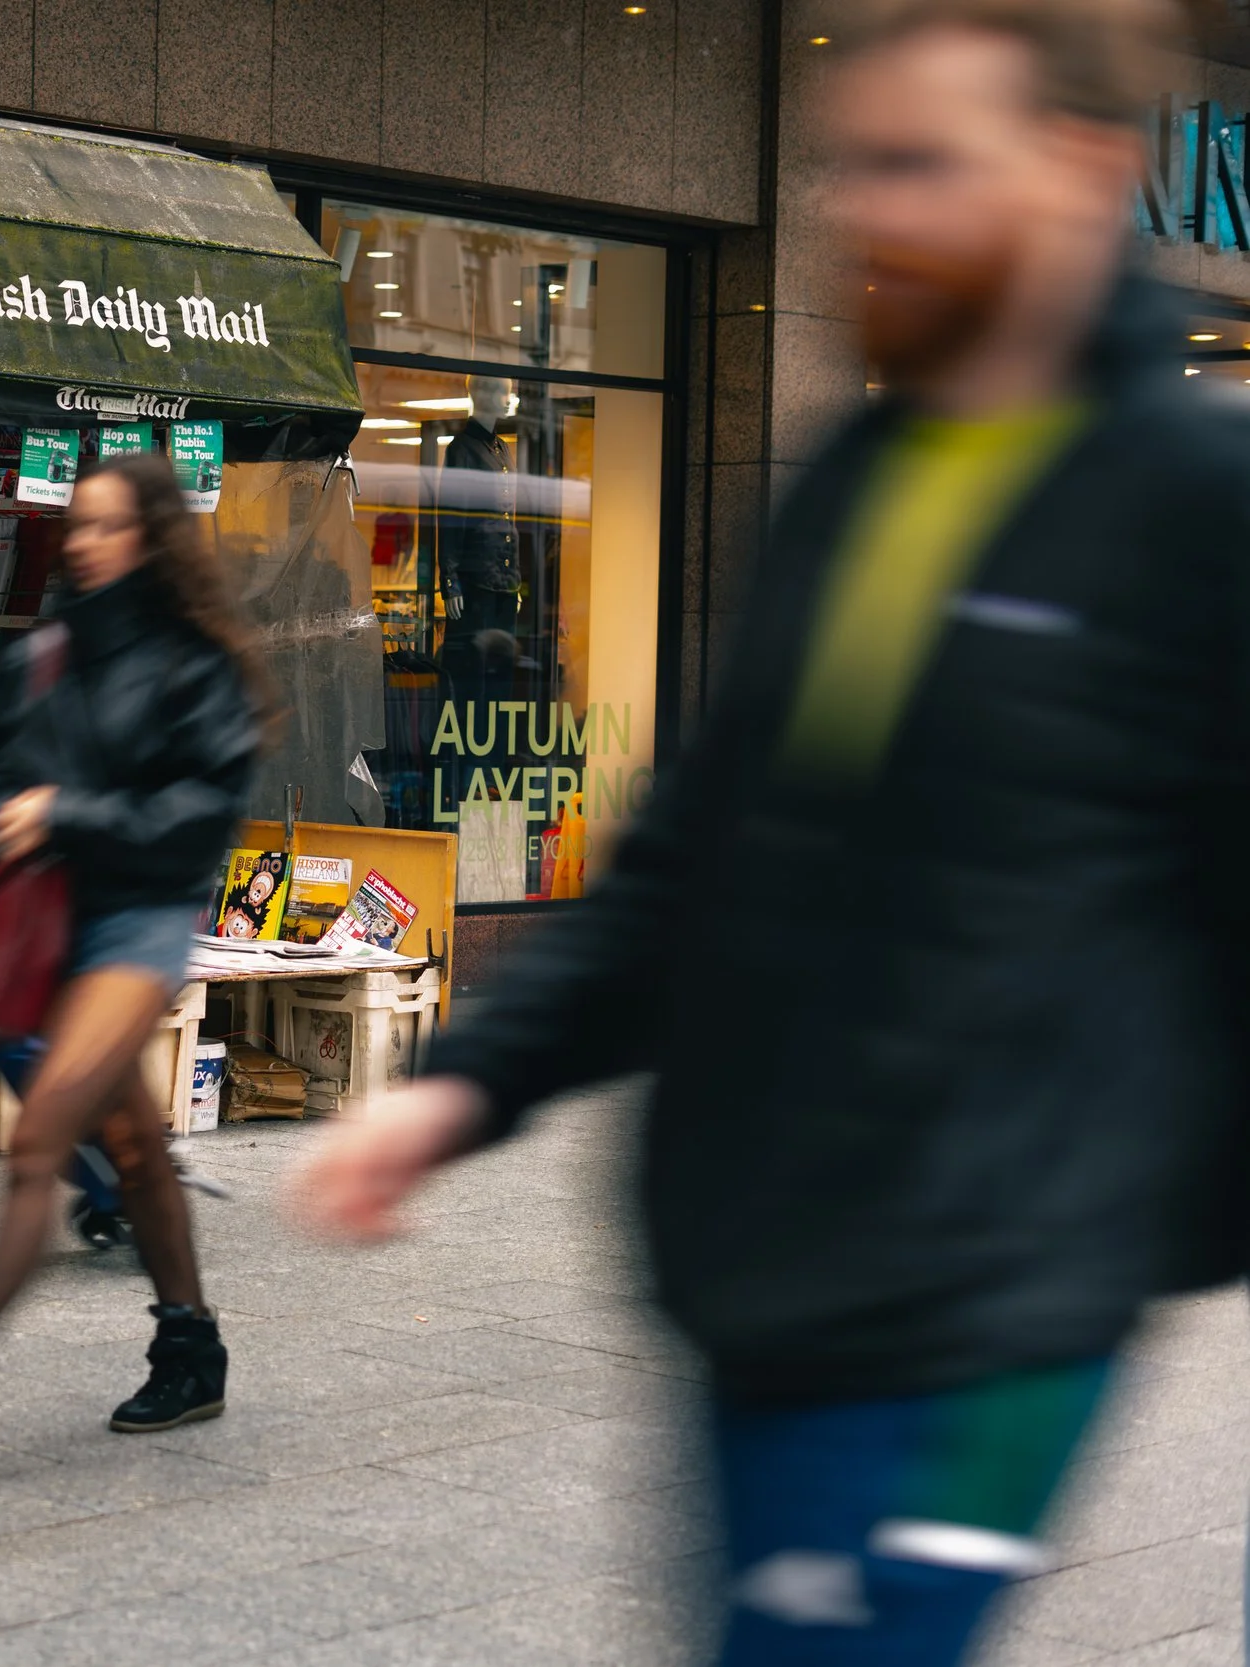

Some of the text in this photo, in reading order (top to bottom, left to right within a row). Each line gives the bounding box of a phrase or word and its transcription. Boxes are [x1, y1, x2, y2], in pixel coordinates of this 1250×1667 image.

[58, 279, 171, 353] Daily
[176, 295, 271, 348] Mail
[56, 386, 101, 411] The
[134, 393, 190, 420] Mail
[102, 427, 141, 444] Hop on
[174, 424, 214, 436] The No.1
[26, 434, 71, 451] Bus Tour
[174, 437, 206, 448] Dublin
[175, 449, 215, 461] Bus Tour
[26, 485, 67, 499] Tickets Here
[200, 497, 213, 506] Here
[430, 700, 631, 756] AUTUMN
[235, 855, 283, 873] BEANO
[297, 859, 340, 871] HISTORY
[294, 867, 341, 881] IRELAND
